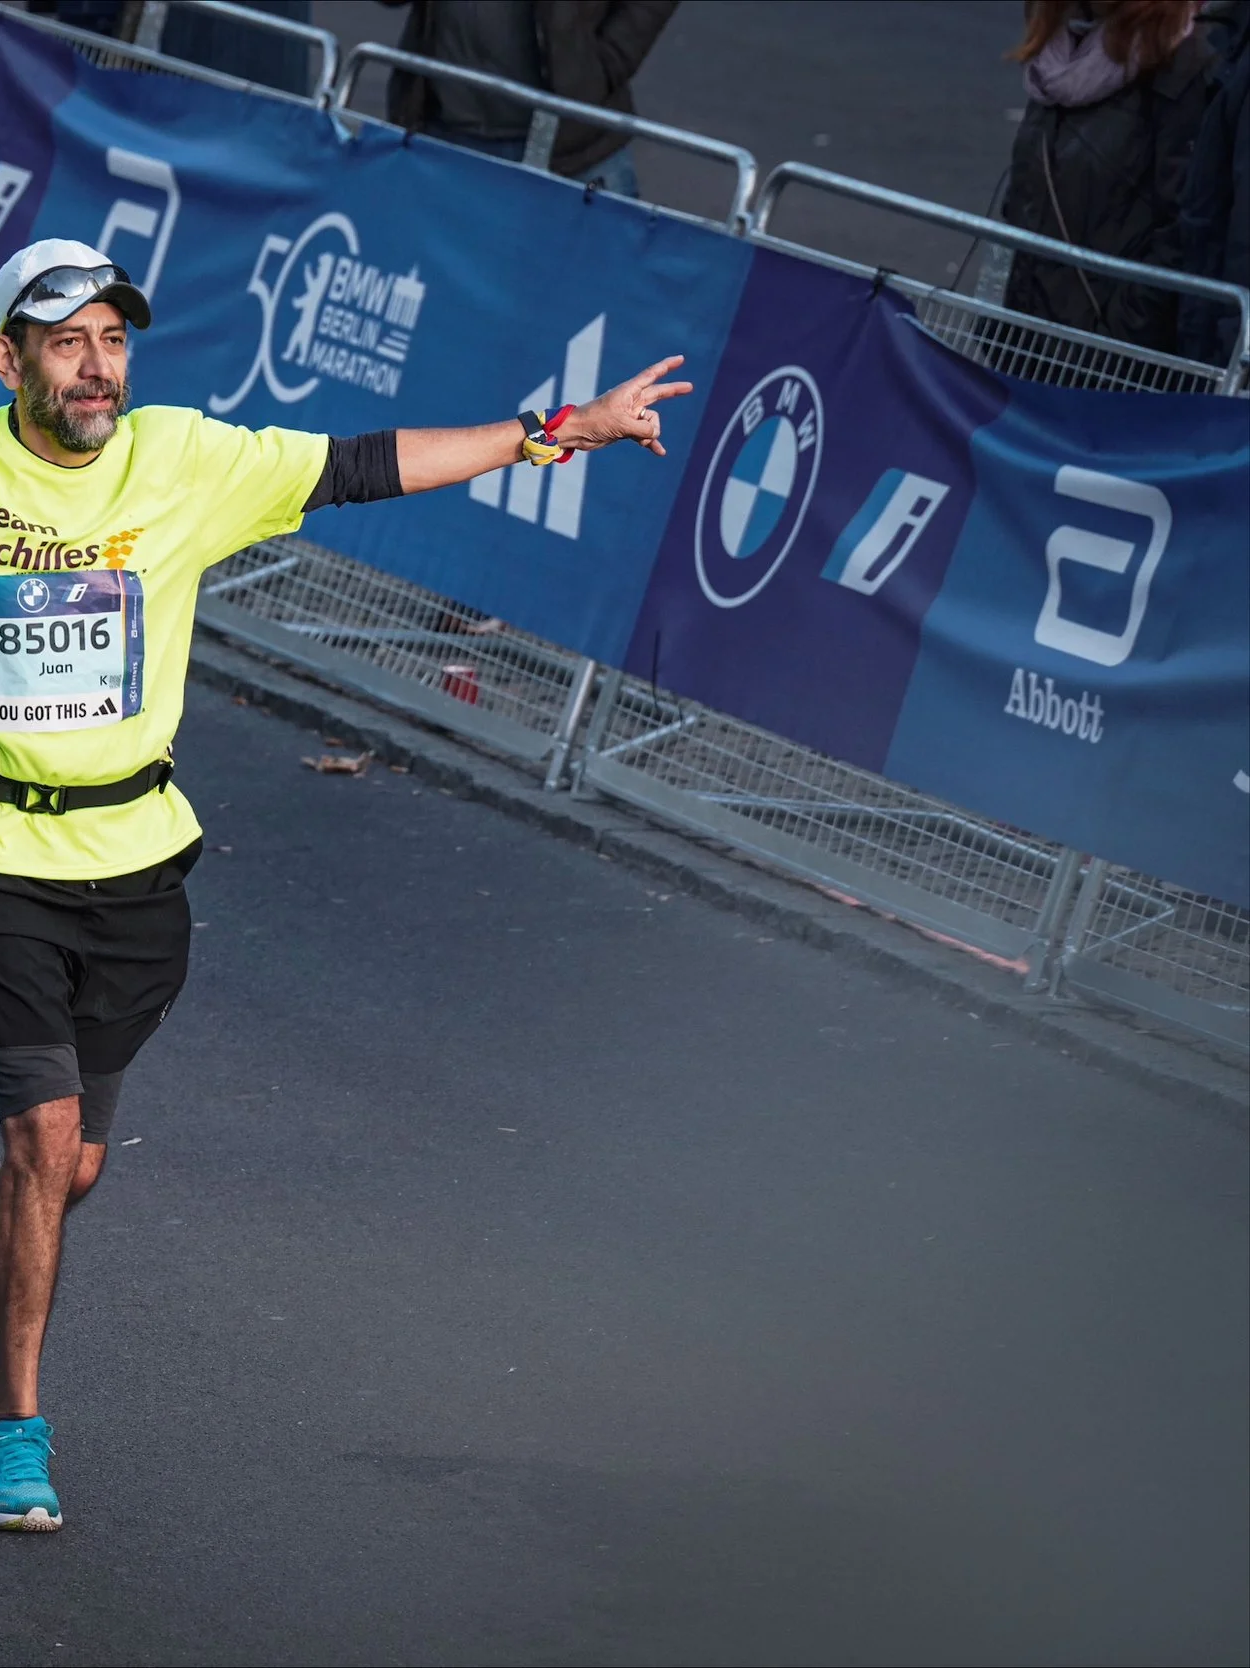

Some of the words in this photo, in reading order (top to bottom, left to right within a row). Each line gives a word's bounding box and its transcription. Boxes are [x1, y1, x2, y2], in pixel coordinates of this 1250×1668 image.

[328, 255, 395, 316] BMW
[317, 303, 382, 350] BERLIN
[307, 340, 403, 399] MARATHON
[741, 378, 817, 453] BMW
[21, 580, 46, 591] BMW
[38, 662, 73, 677] Juan
[100, 675, 108, 686] K
[24, 705, 52, 721] GOT
[56, 702, 87, 719] THIS
[1004, 667, 1105, 744] Abbott
